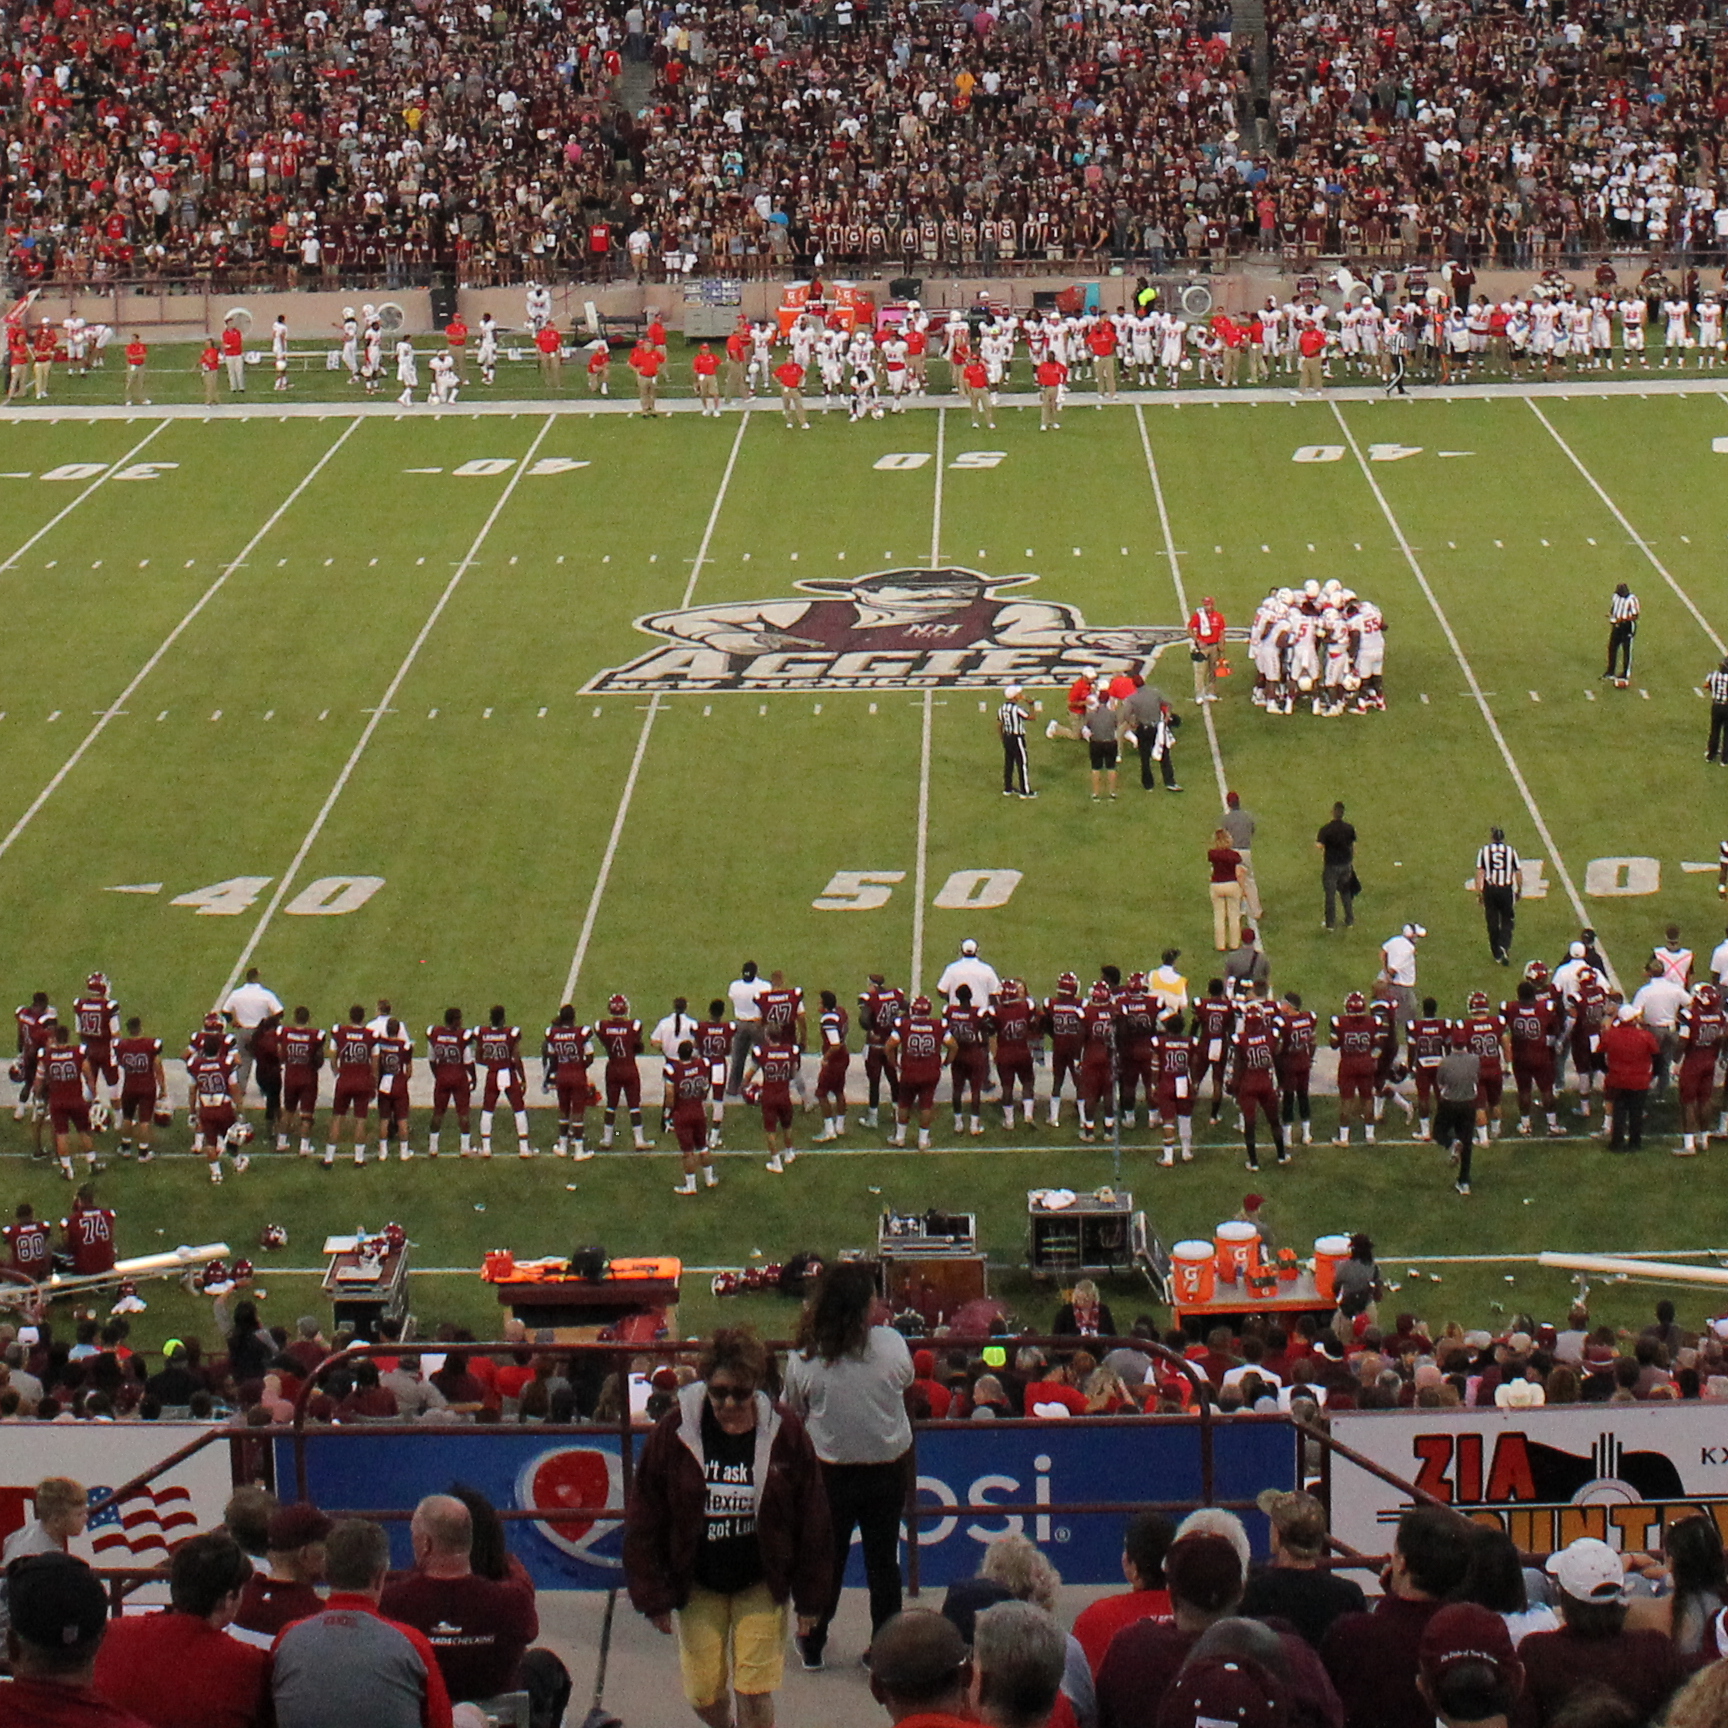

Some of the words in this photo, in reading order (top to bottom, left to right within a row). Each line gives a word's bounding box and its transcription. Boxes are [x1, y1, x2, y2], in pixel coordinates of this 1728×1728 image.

[873, 450, 1009, 471] 50
[1291, 443, 1424, 464] 40
[39, 462, 180, 481] 30
[451, 457, 592, 477] 40
[1363, 617, 1381, 634] 55
[613, 648, 1137, 681] AGGIES
[606, 679, 721, 691] NEW
[751, 676, 941, 688] MEXICO
[972, 674, 1082, 687] STAT
[1491, 852, 1505, 870] S
[169, 875, 386, 916] 40
[811, 869, 1024, 912] 50
[722, 1462, 748, 1483] ask
[1413, 1432, 1537, 1503] ZIA
[707, 1519, 731, 1541] got
